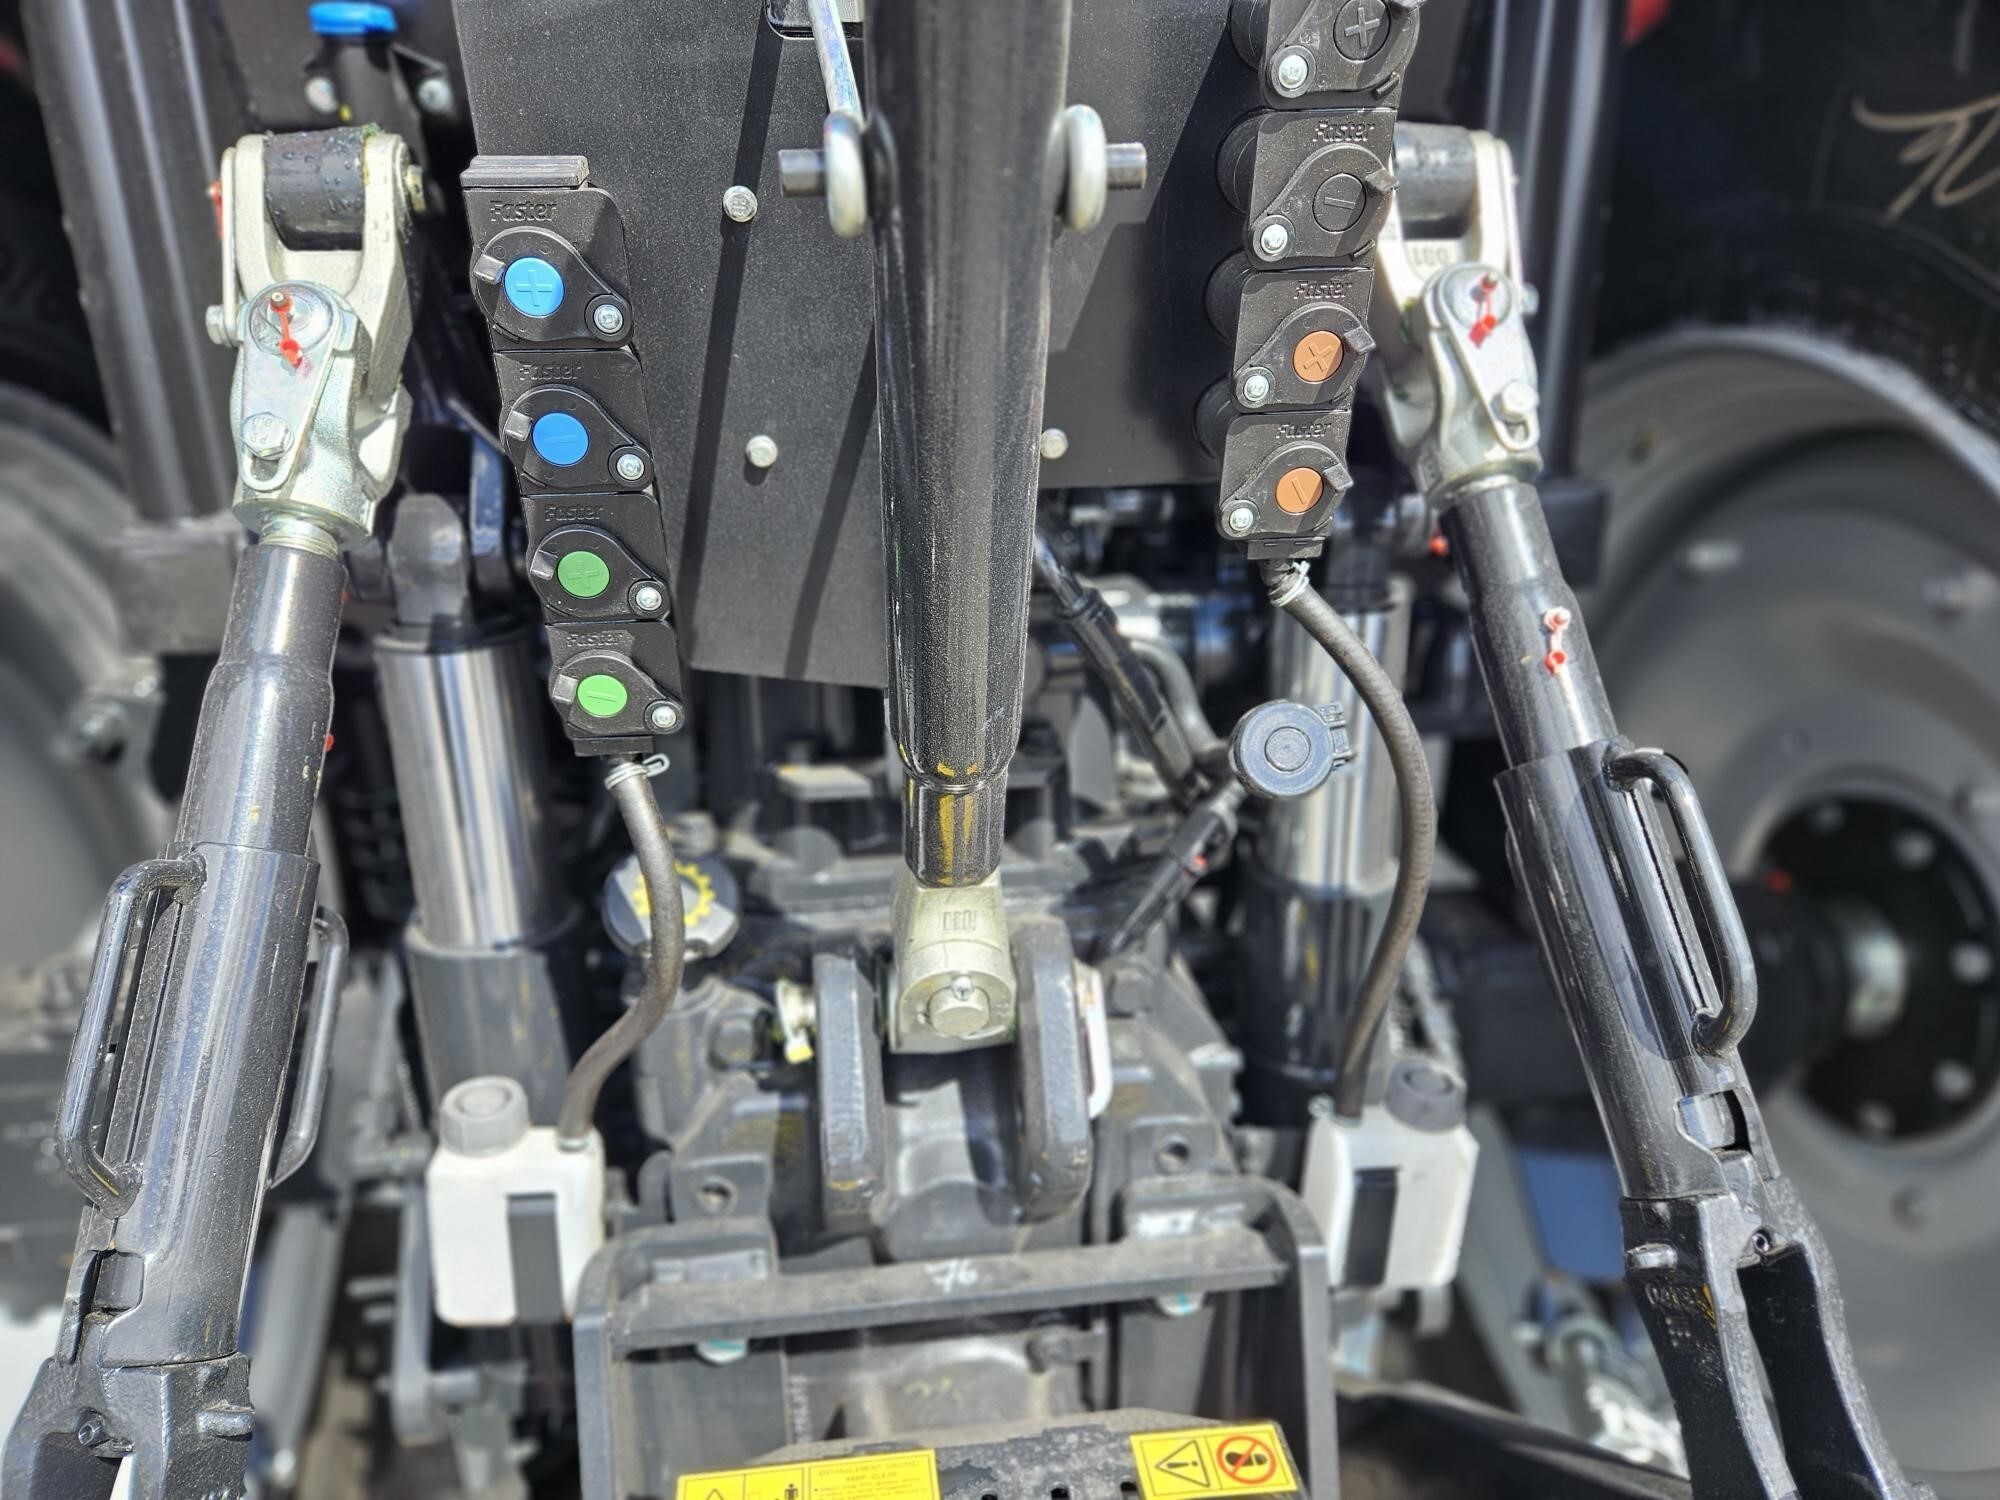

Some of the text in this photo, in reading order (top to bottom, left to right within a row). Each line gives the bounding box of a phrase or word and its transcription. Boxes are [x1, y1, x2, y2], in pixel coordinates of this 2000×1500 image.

[1312, 121, 1376, 142] Faster
[490, 200, 558, 222] Faster
[1293, 280, 1353, 300] Faster
[518, 362, 583, 381] Faster
[1275, 421, 1332, 439] Faster
[544, 503, 604, 522] Faster
[566, 631, 624, 648] Faster
